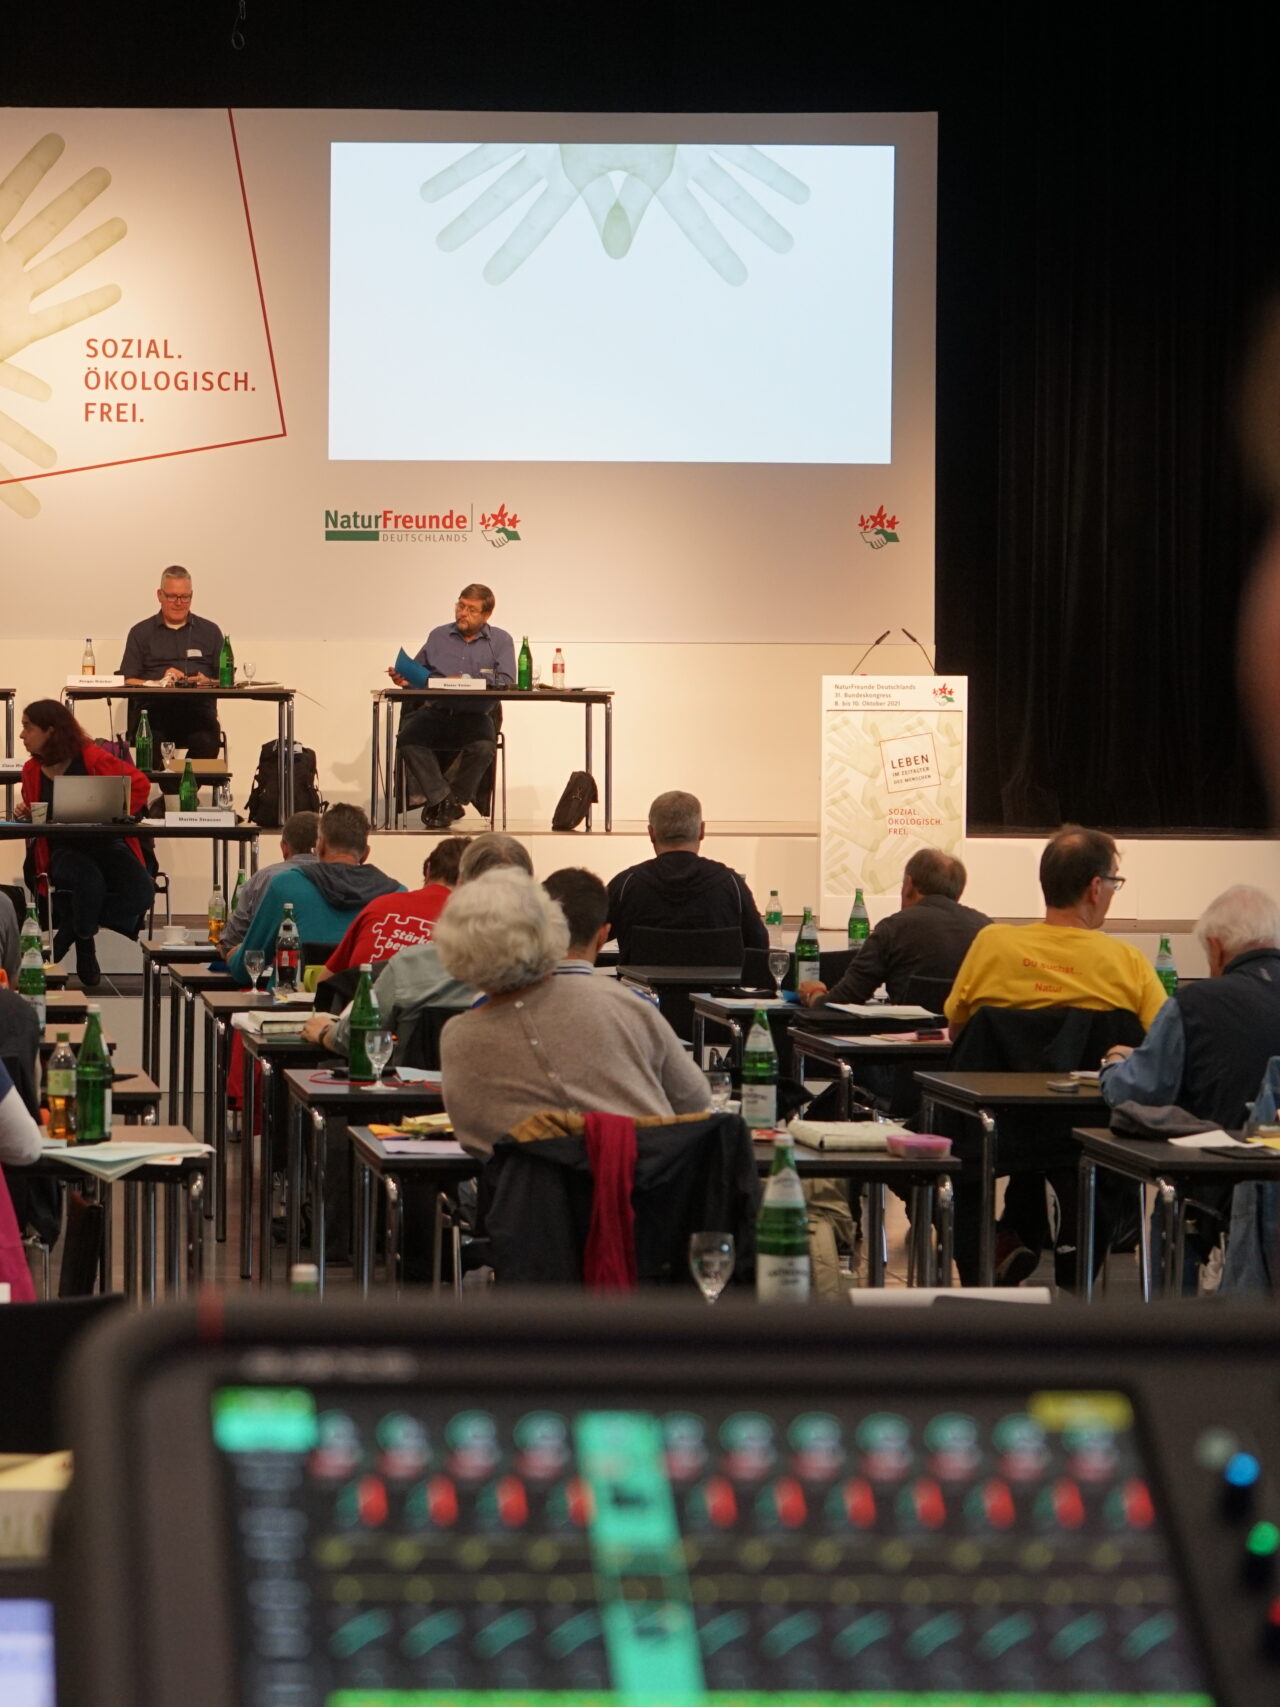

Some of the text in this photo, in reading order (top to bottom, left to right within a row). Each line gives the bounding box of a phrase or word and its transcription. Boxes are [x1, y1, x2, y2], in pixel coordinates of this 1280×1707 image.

[85, 338, 183, 360] SOZIAL.
[84, 366, 257, 392] ÖKOLOGISCH.
[84, 402, 145, 423] FREI.
[324, 509, 468, 529] NaturFreunde
[382, 533, 468, 543] DEUTSCHLANDS
[844, 692, 892, 700] Bundeskongress
[890, 754, 930, 769] LEBEN
[888, 808, 920, 816] SOZIAL.
[384, 938, 408, 951] ber
[391, 929, 434, 945] Stärke
[1022, 957, 1037, 968] Du
